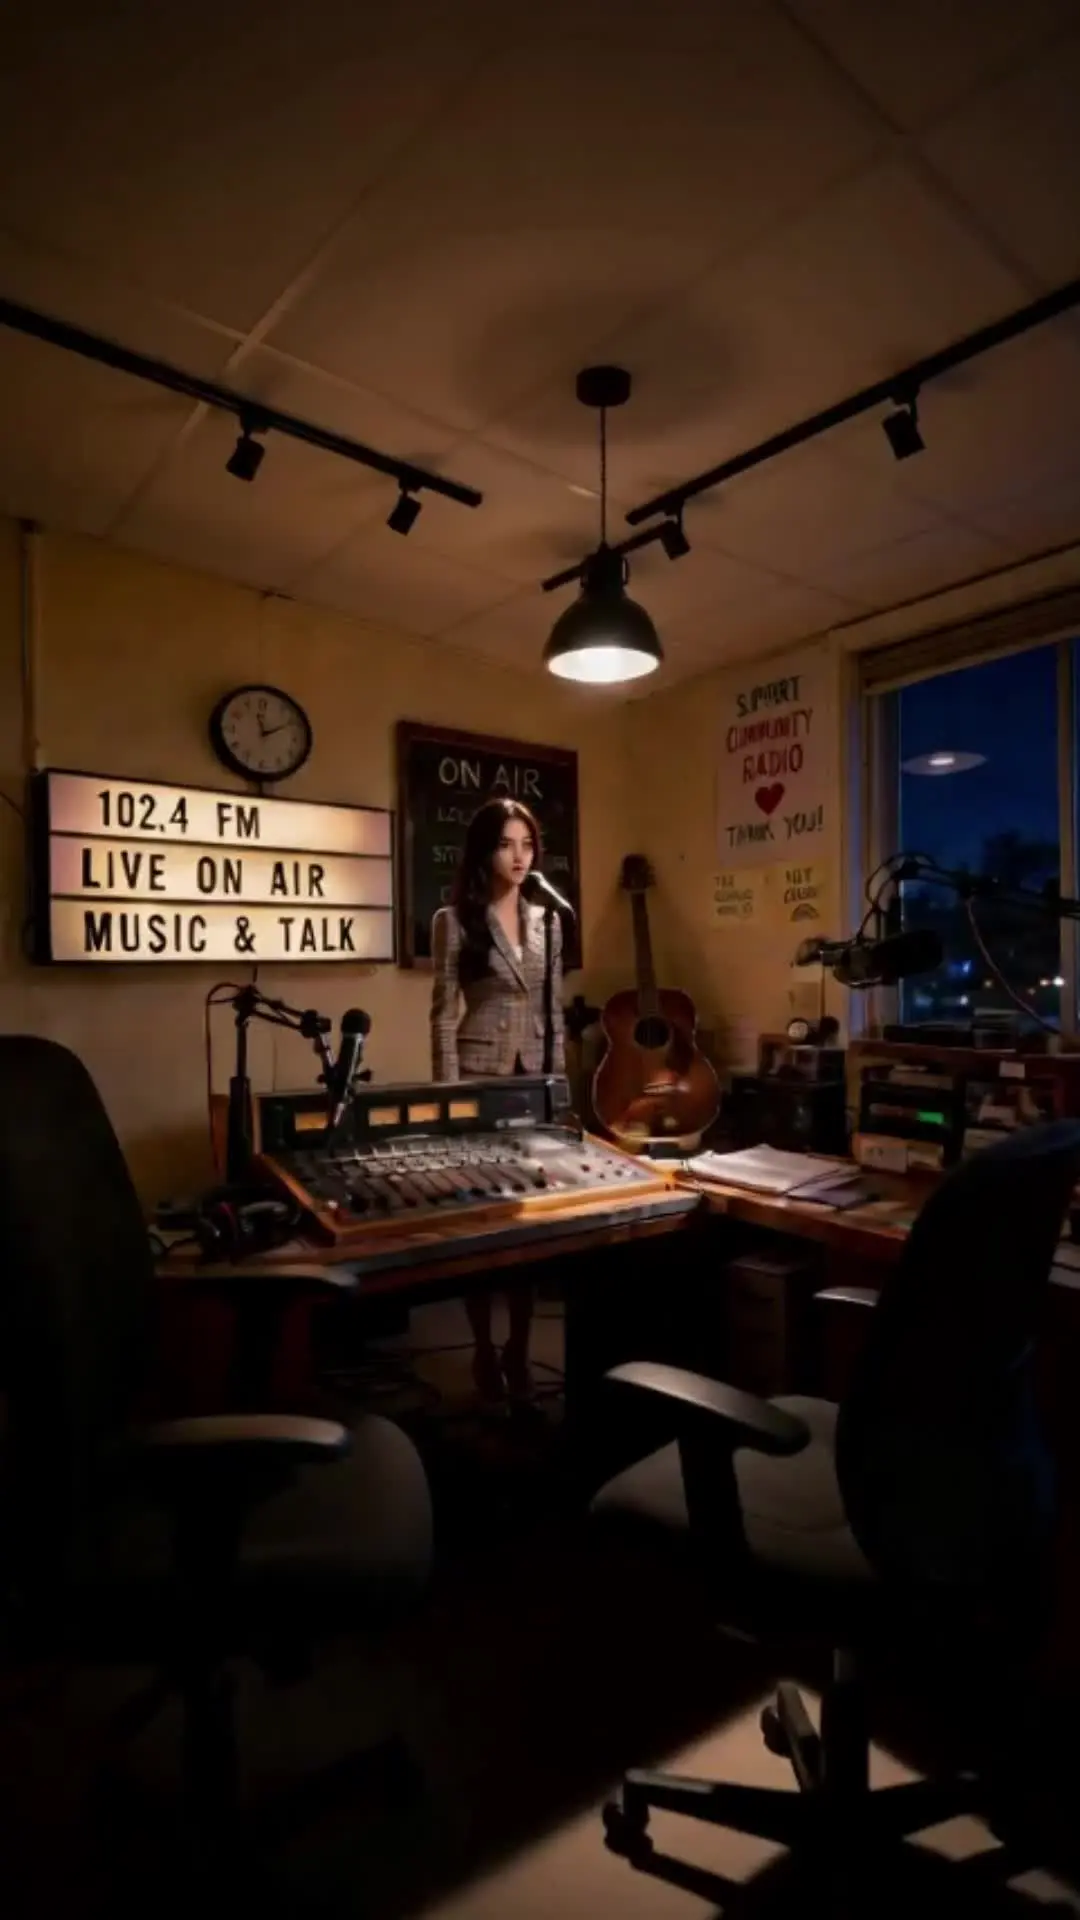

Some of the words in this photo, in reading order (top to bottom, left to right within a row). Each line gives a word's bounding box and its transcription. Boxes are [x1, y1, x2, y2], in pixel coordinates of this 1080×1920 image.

[437, 755, 482, 790] ON
[491, 762, 545, 801] AIR
[742, 743, 804, 784] RADIO
[216, 802, 260, 839] FM
[81, 847, 167, 892] LIVE
[196, 856, 244, 895] ON
[270, 861, 326, 898] AIR
[83, 910, 208, 954] MUSIC
[233, 916, 257, 955] &
[277, 917, 357, 953] TALK
